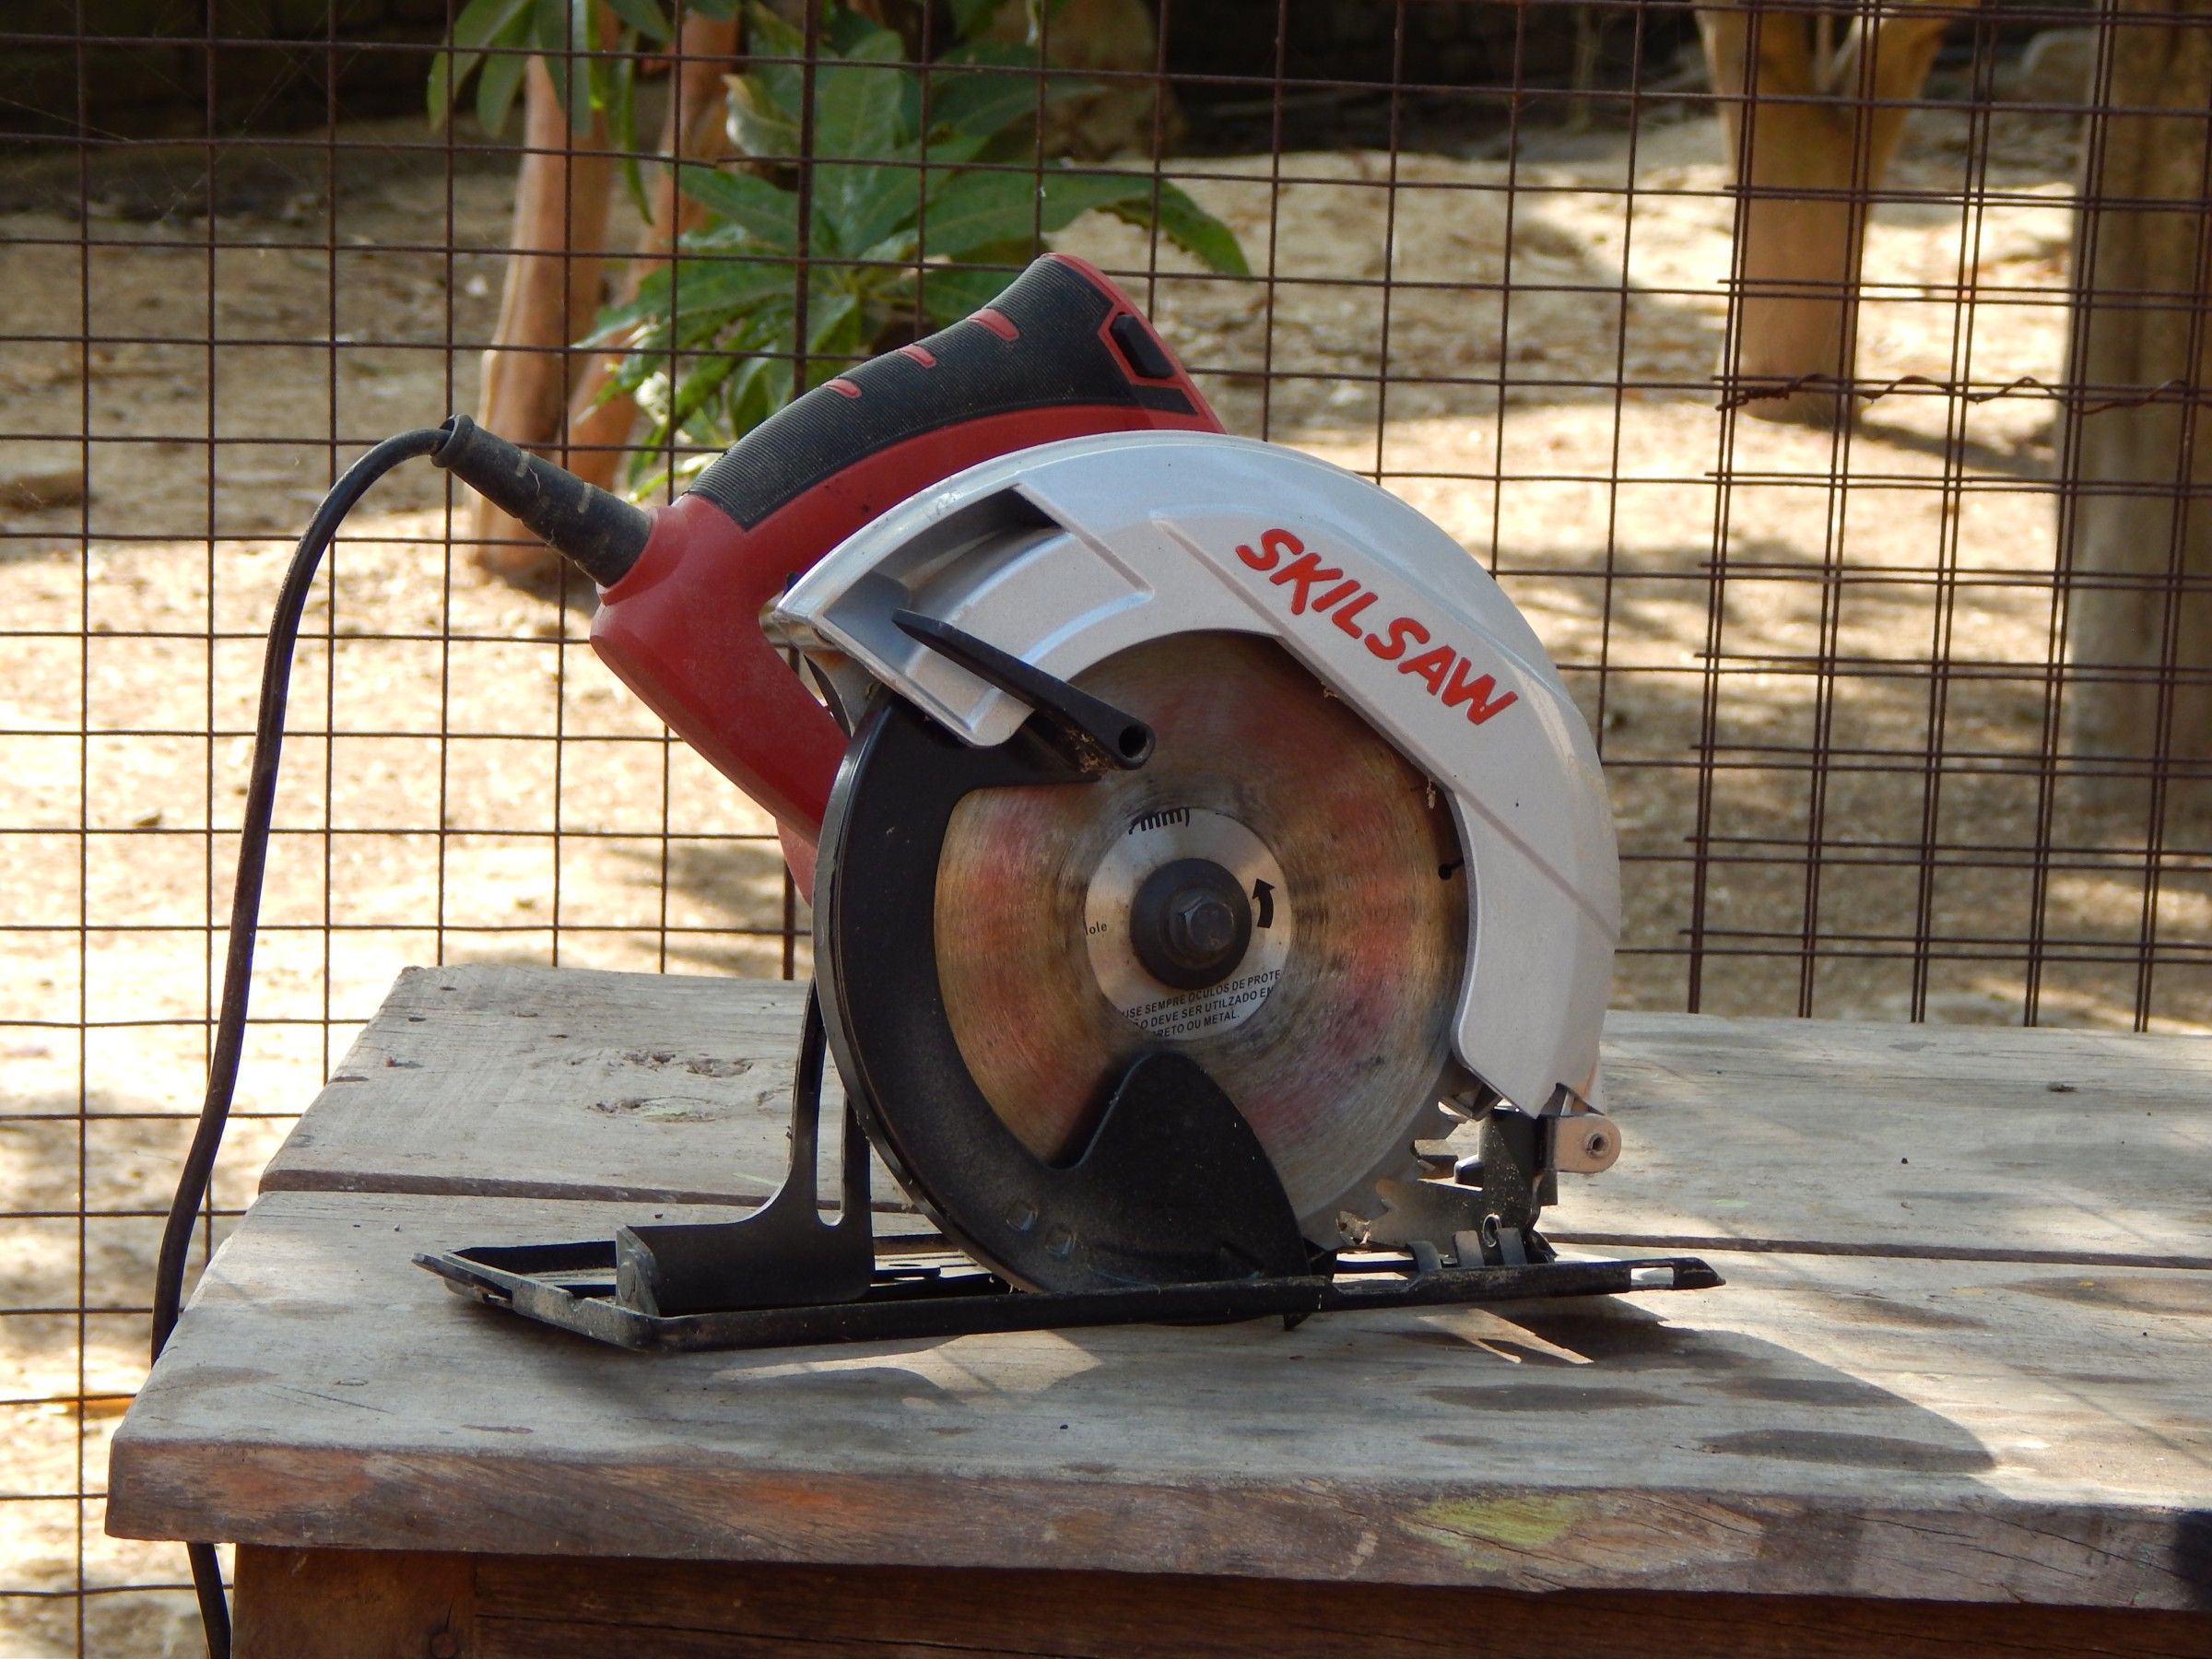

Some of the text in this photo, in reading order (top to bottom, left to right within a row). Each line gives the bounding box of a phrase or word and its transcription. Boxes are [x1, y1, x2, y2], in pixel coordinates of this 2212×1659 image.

[1235, 528, 1519, 725] SKILSAW
[1145, 994, 1185, 1015] SEMPRE
[1232, 979, 1245, 991] DE
[1150, 1011, 1179, 1028] DEVE
[1181, 1005, 1203, 1019] SER
[1153, 1010, 1240, 1038] RETO OU METAL.
